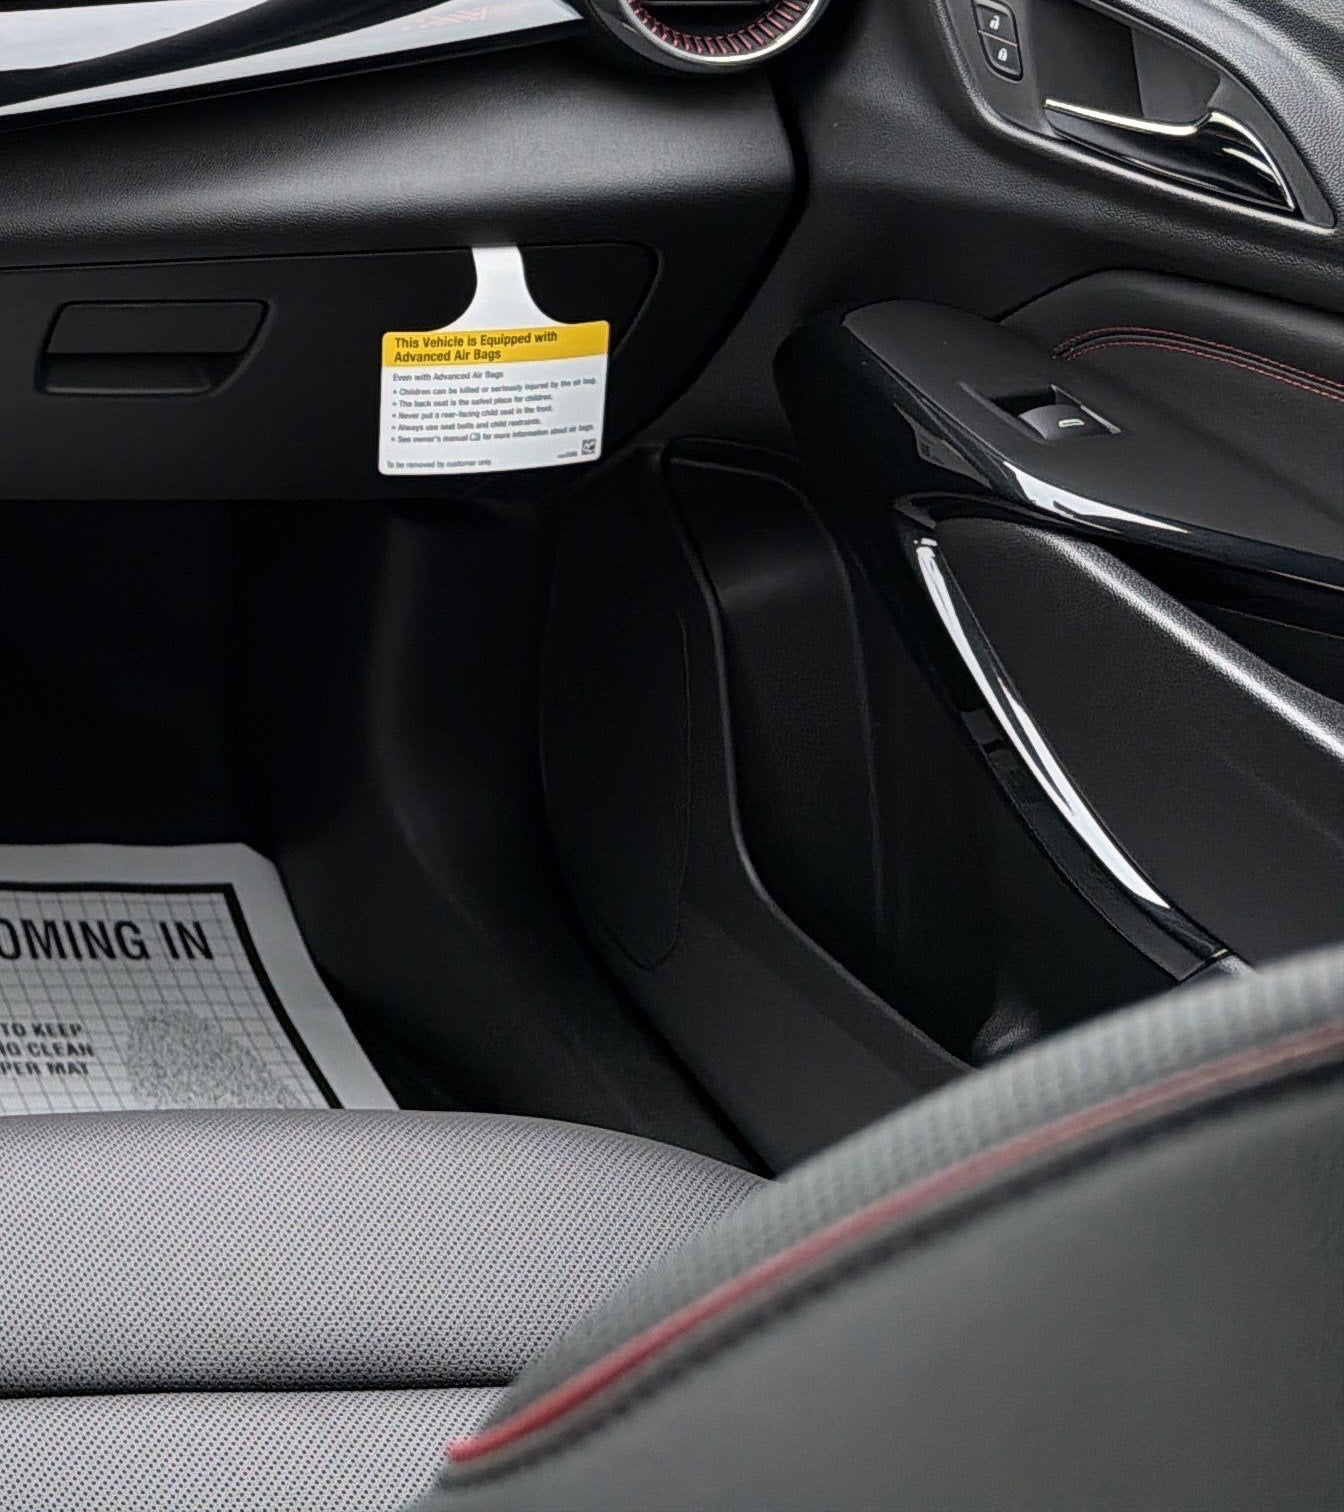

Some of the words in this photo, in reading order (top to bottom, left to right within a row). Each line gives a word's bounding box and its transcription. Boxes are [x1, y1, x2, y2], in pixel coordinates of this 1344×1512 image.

[394, 337, 420, 349] This
[422, 335, 464, 348] Vehicle
[467, 334, 477, 347] is
[480, 332, 532, 347] Equipped
[534, 331, 558, 343] with
[393, 350, 451, 363] Advanced
[454, 349, 471, 361] Air
[473, 349, 502, 362] Bags
[393, 373, 412, 381] Even
[414, 373, 432, 381] with
[433, 372, 471, 381] Advanced
[472, 371, 483, 379] Air
[485, 370, 504, 379] Bags
[159, 920, 216, 961] IN
[30, 1021, 82, 1037] KEEP
[26, 1041, 95, 1057] CLEAN
[45, 1061, 90, 1076] MAT
